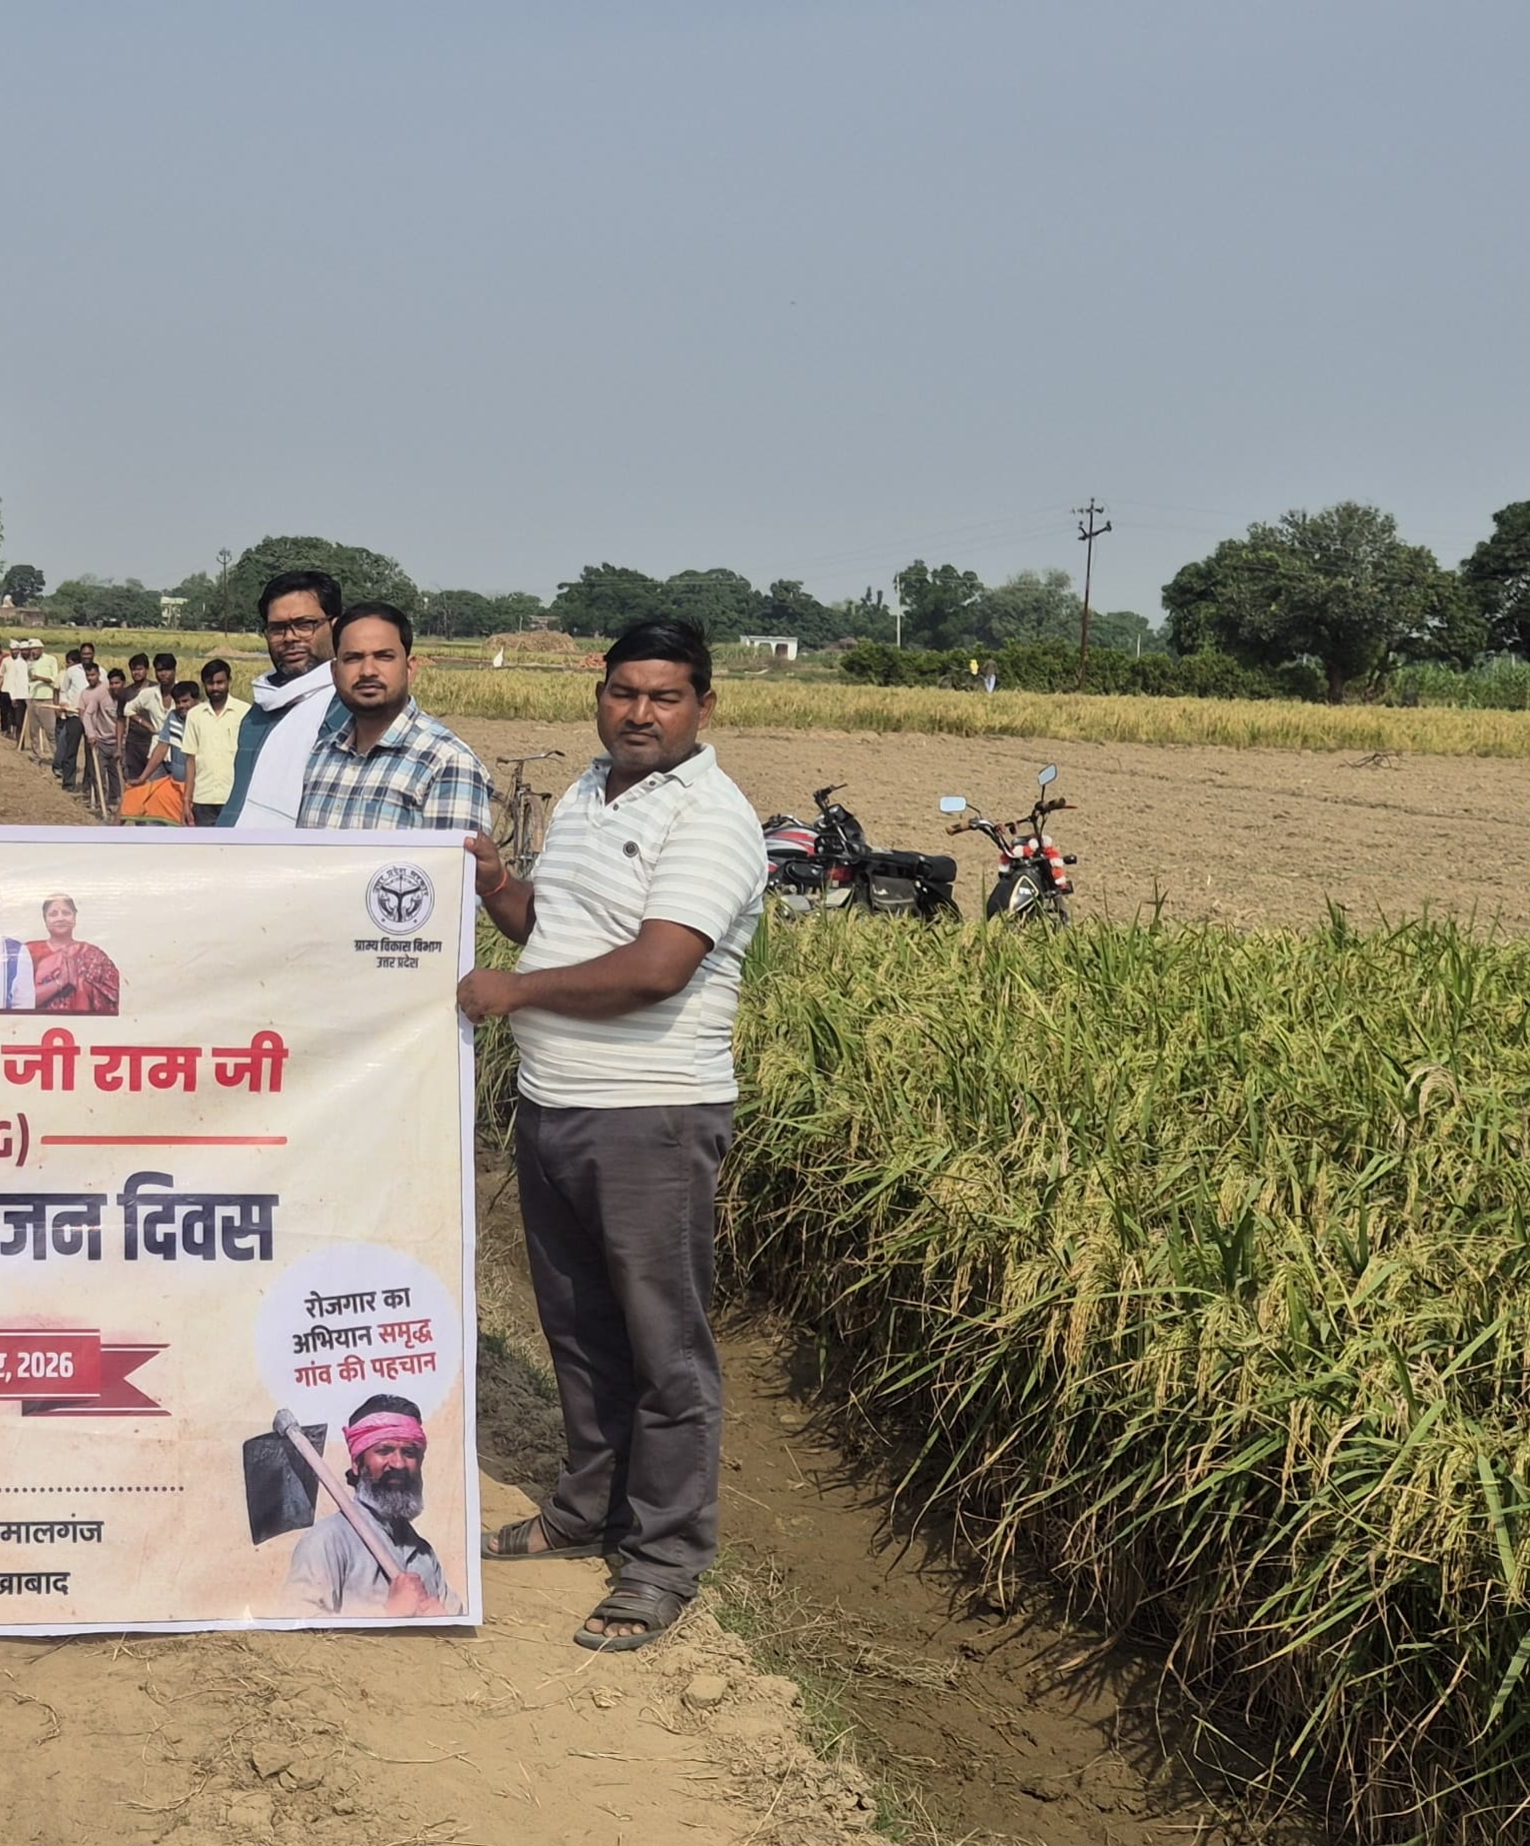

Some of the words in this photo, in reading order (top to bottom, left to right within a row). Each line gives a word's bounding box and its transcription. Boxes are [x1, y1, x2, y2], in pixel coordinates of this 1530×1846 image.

[354, 940, 379, 951] ग्राम्य
[380, 937, 412, 952] विकास
[413, 938, 442, 952] विभाग
[377, 957, 396, 968] उत्तर
[397, 954, 419, 968] प्रदेश
[1, 1028, 81, 1091] जी
[90, 1046, 202, 1092] राम
[212, 1031, 289, 1093] जी
[117, 1171, 279, 1261] दिवस
[304, 1291, 376, 1318] रोजगार
[382, 1288, 410, 1309] का
[293, 1325, 372, 1356] अभियान
[377, 1319, 433, 1349] समृद्ध
[18, 1352, 73, 1377] 2026
[294, 1361, 331, 1387] गांव
[337, 1355, 365, 1382] की
[370, 1352, 436, 1380] पहचान
